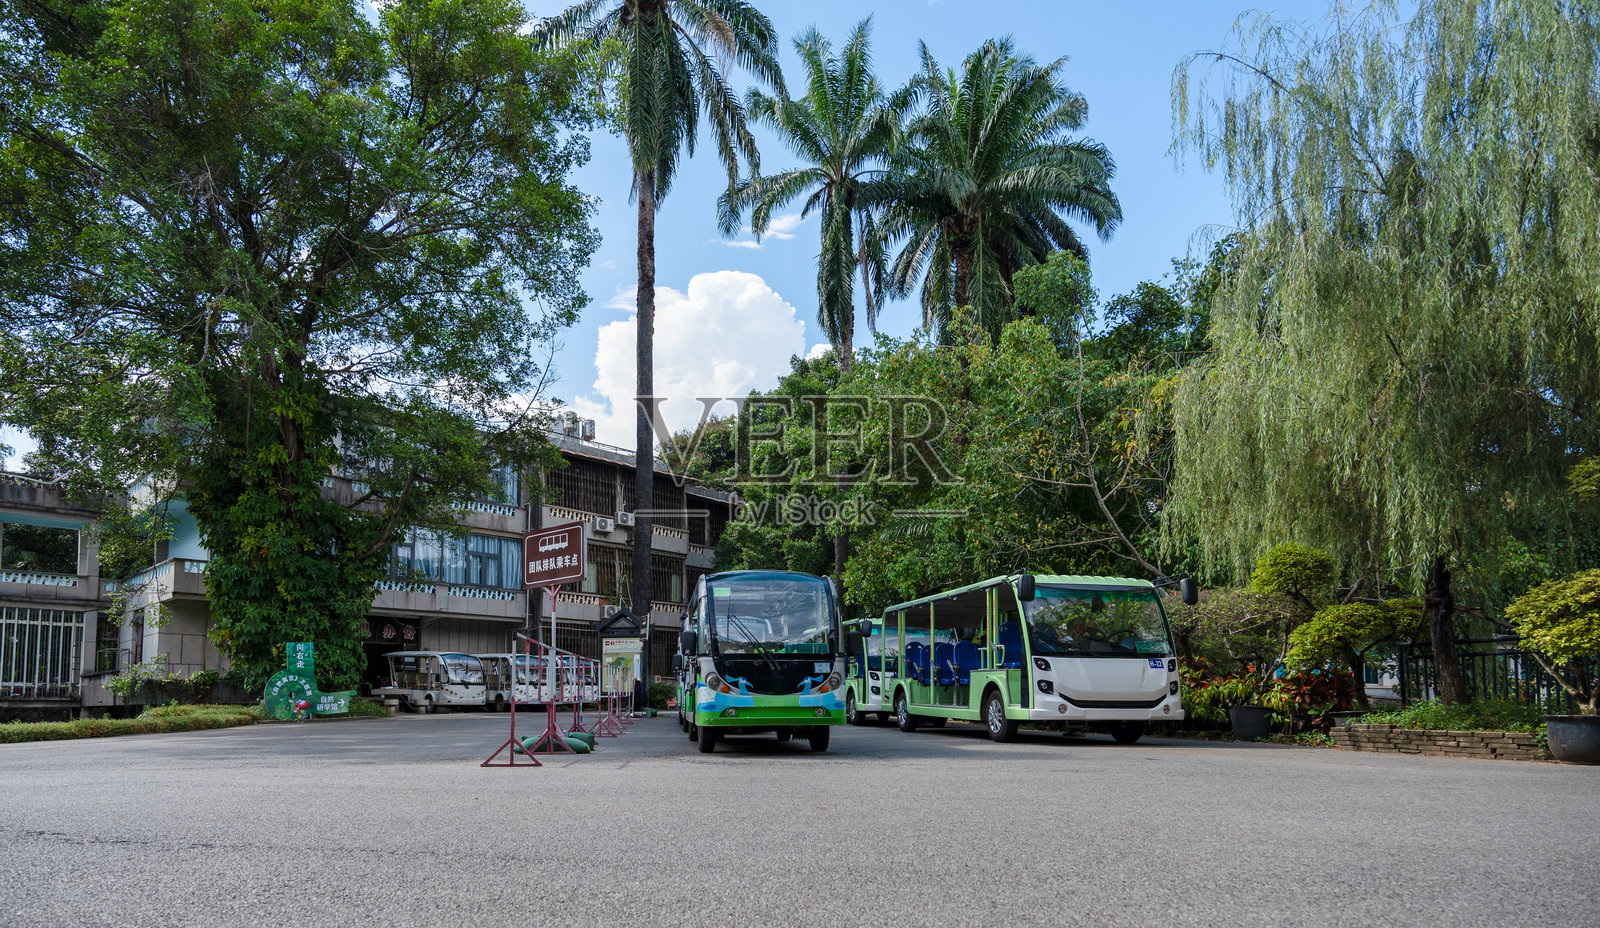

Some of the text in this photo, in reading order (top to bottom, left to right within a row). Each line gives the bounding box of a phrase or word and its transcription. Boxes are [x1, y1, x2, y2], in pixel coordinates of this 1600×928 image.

[529, 553, 578, 574] 团队排队乘车点
[296, 643, 305, 668] 向右走
[316, 703, 339, 711] 研学馆
